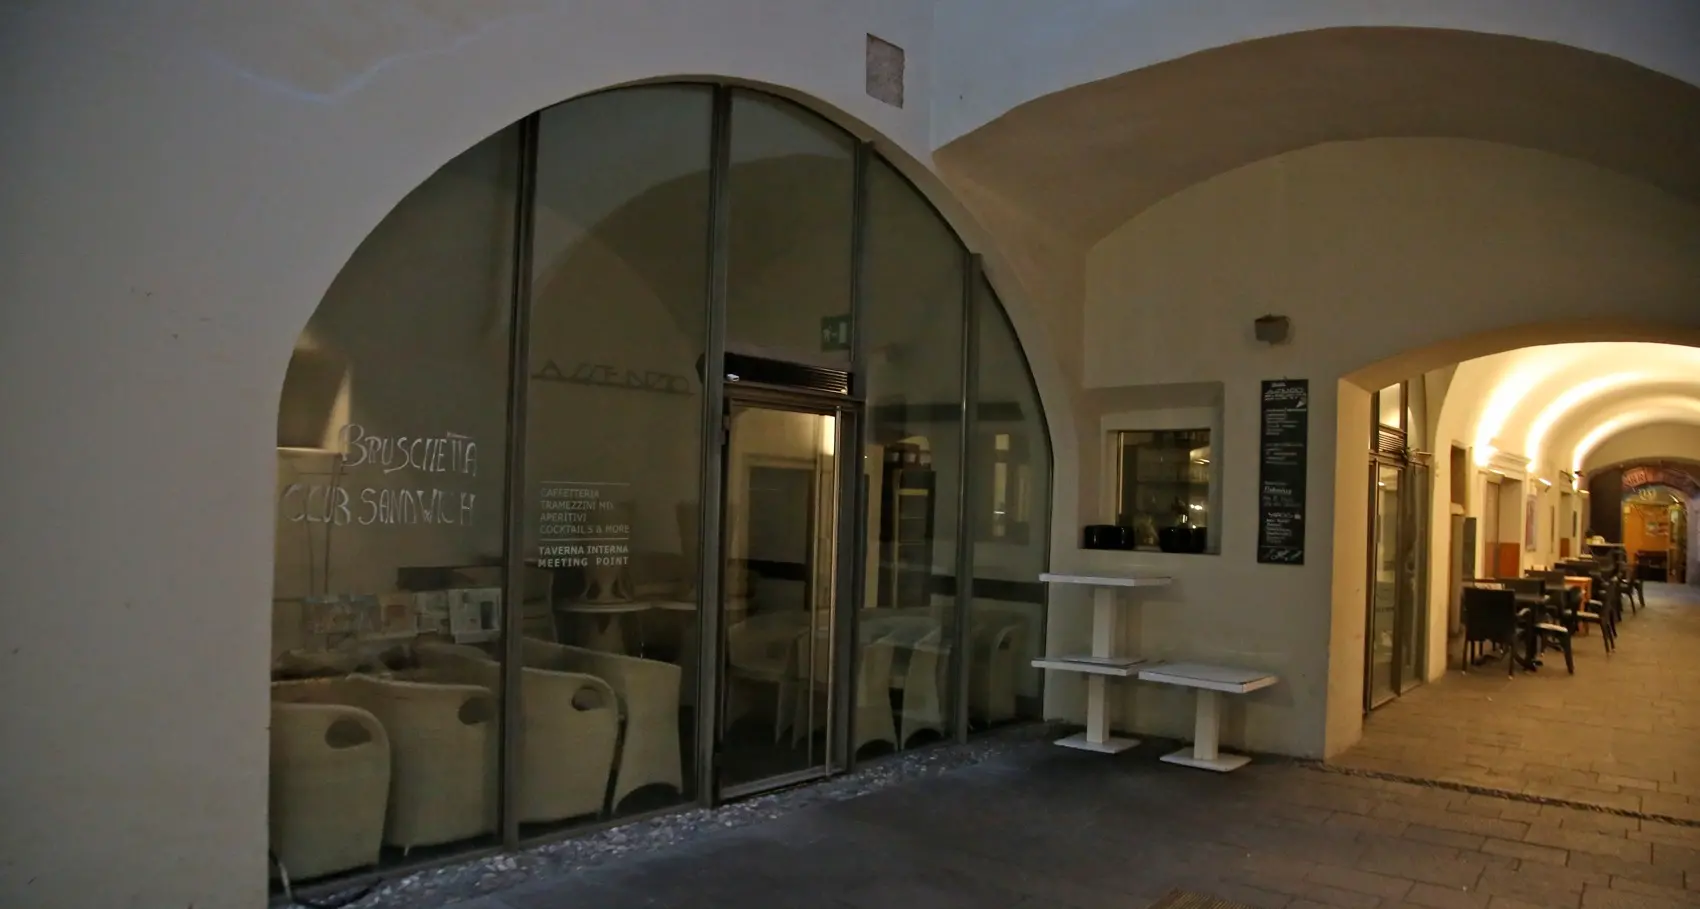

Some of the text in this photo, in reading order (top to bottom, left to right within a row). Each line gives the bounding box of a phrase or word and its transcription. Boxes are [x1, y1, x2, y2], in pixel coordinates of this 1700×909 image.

[540, 487, 600, 498] CAFFETTERIA
[283, 483, 477, 527] CLUB SANDWICH
[540, 500, 596, 510] TRAMEZZINI
[540, 512, 587, 522] APERITIVI
[539, 524, 593, 534] COCKTAILS
[605, 524, 630, 534] MORE
[538, 545, 629, 556] TAVERNA INTERNA
[537, 556, 629, 568] MEETING POINT
